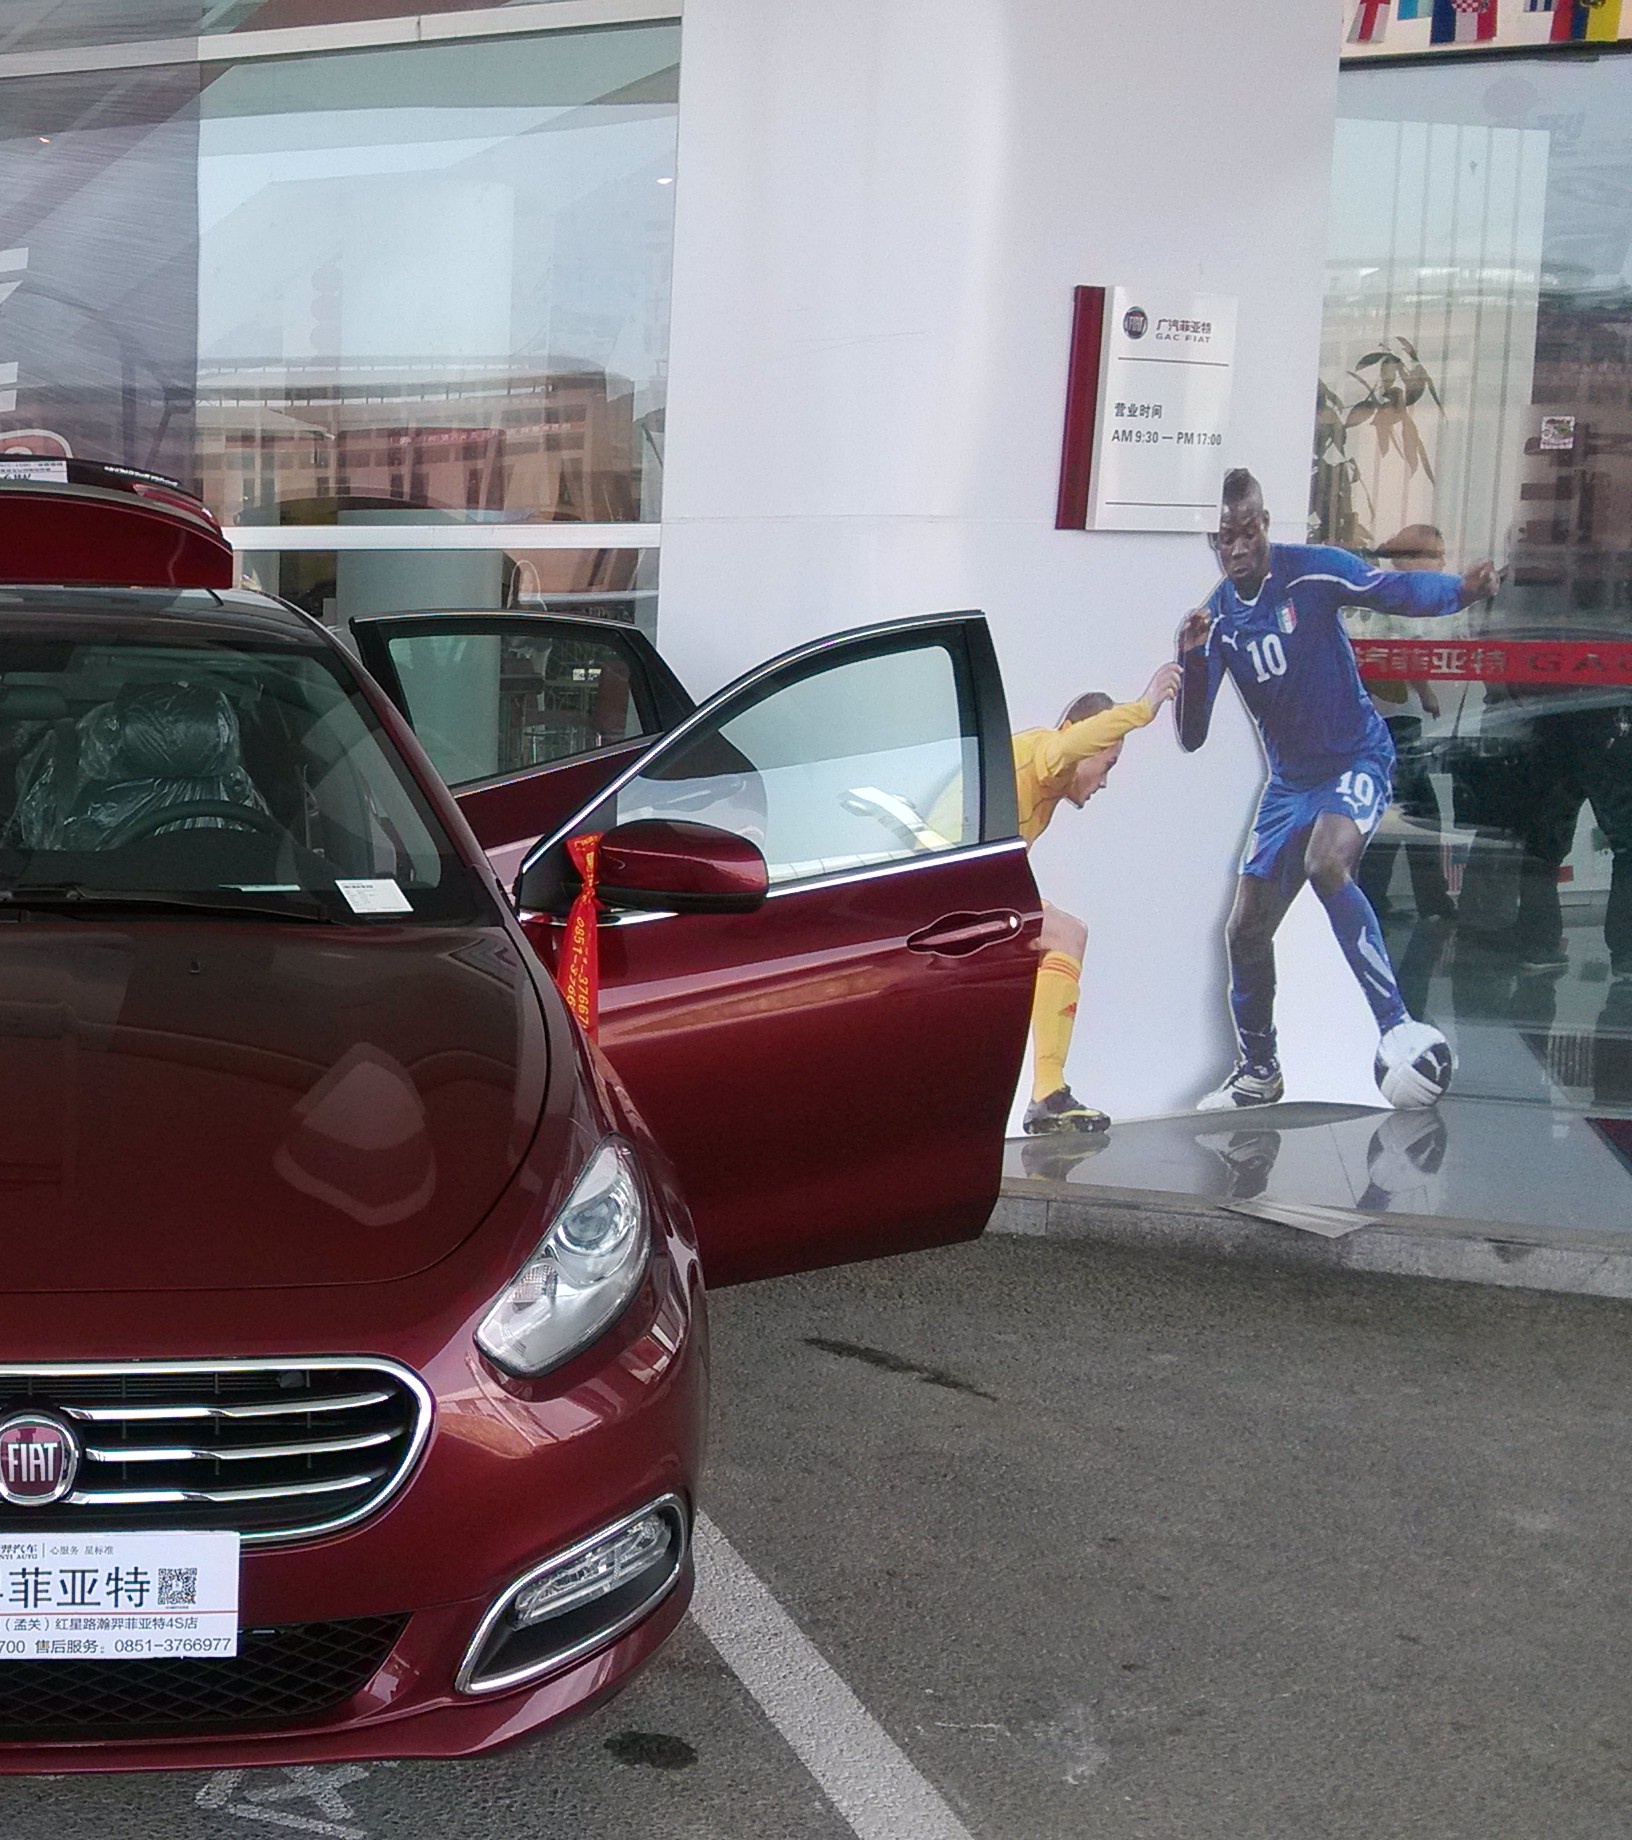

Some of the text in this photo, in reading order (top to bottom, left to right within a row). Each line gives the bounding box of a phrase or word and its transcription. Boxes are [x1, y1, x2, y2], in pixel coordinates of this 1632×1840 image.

[1156, 319, 1212, 334] 广汽菲亚特
[1155, 333, 1212, 343] GAC FIAT
[1114, 402, 1163, 419] 营业时间
[1111, 430, 1133, 442] AM
[1135, 430, 1159, 444] 9:30
[1176, 432, 1194, 445] PM
[1197, 434, 1222, 445] 17:00
[1247, 633, 1287, 683] 10
[1336, 771, 1374, 806] 10
[7, 1442, 58, 1482] FIAT
[114, 1637, 232, 1653] 0851-3766977
